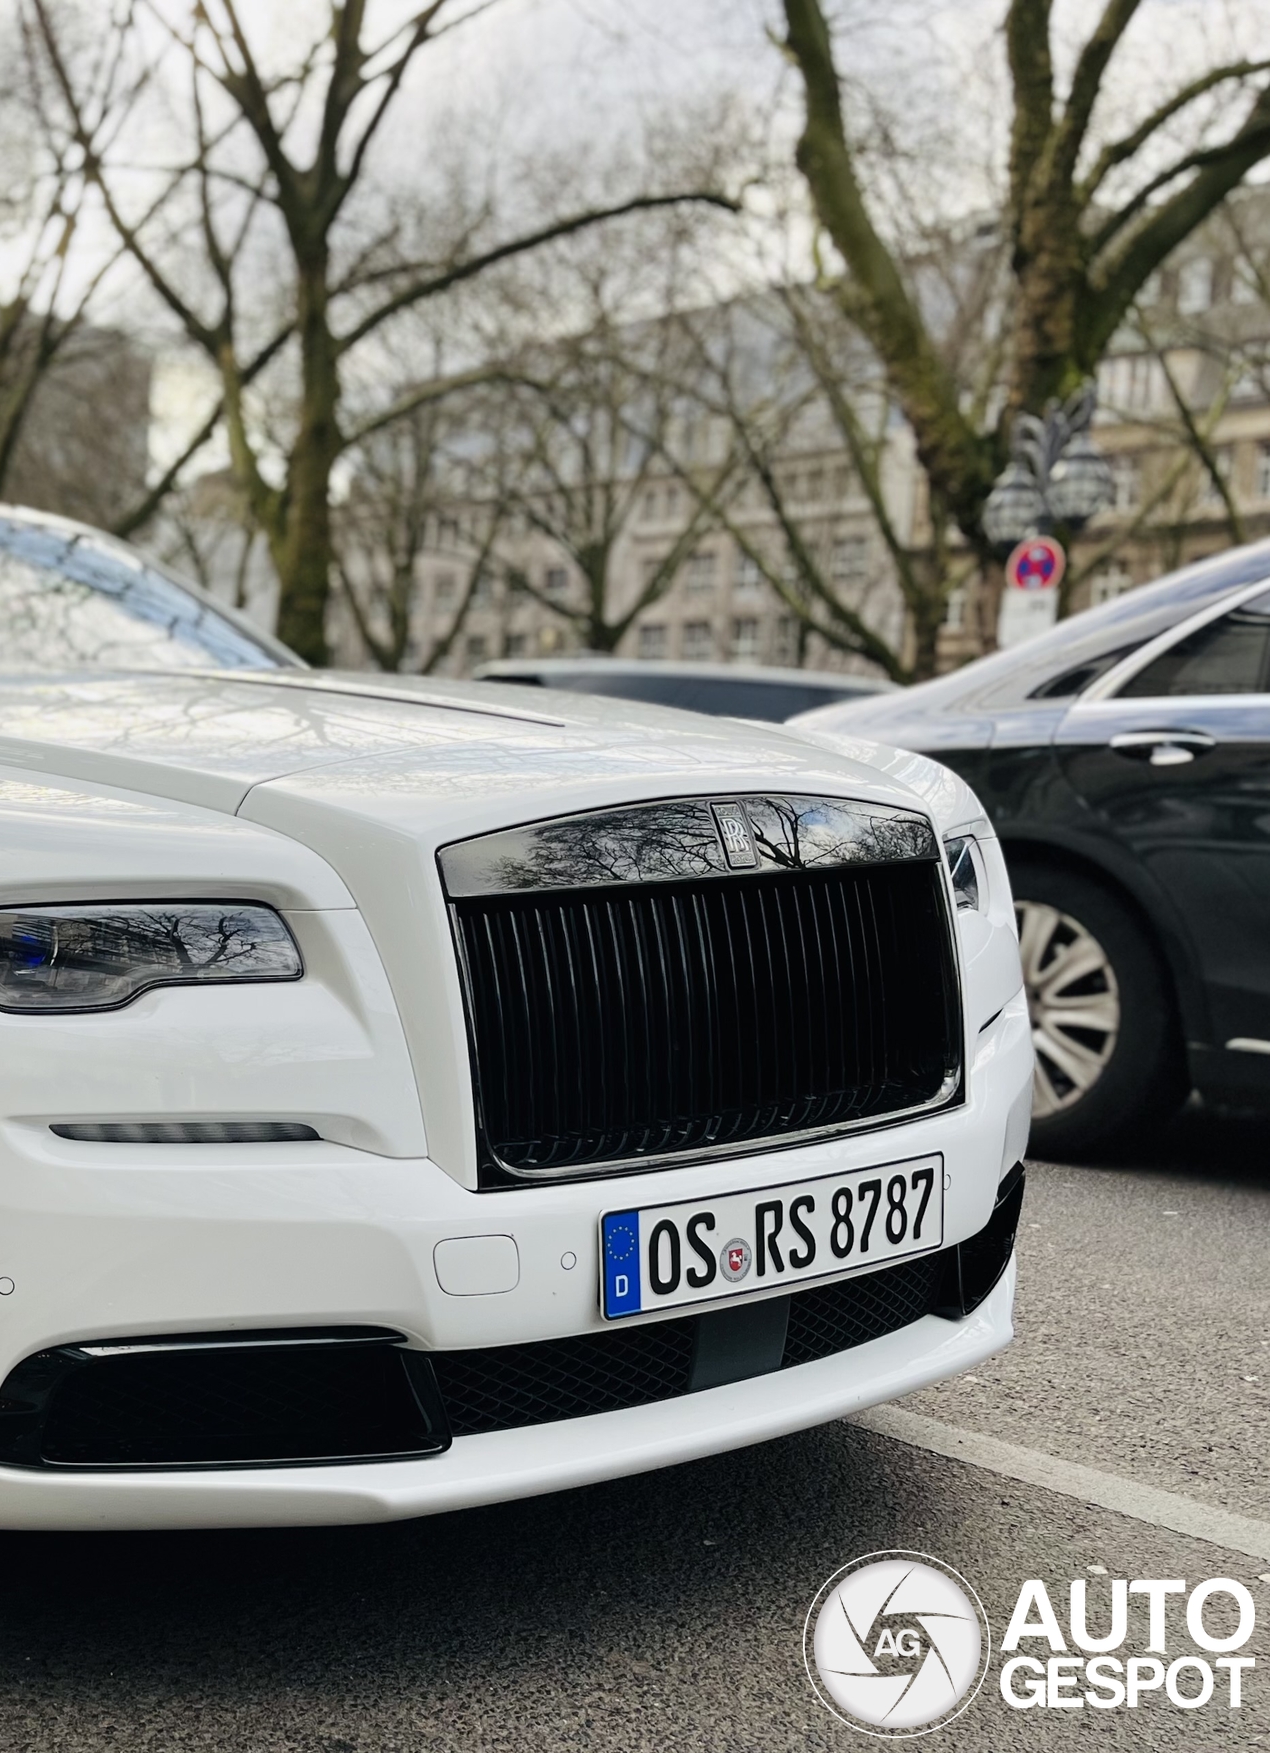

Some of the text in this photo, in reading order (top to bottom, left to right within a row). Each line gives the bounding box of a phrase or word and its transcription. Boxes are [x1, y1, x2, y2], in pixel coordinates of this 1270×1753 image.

[648, 1167, 934, 1295] OS RS 8787
[615, 1274, 629, 1297] D
